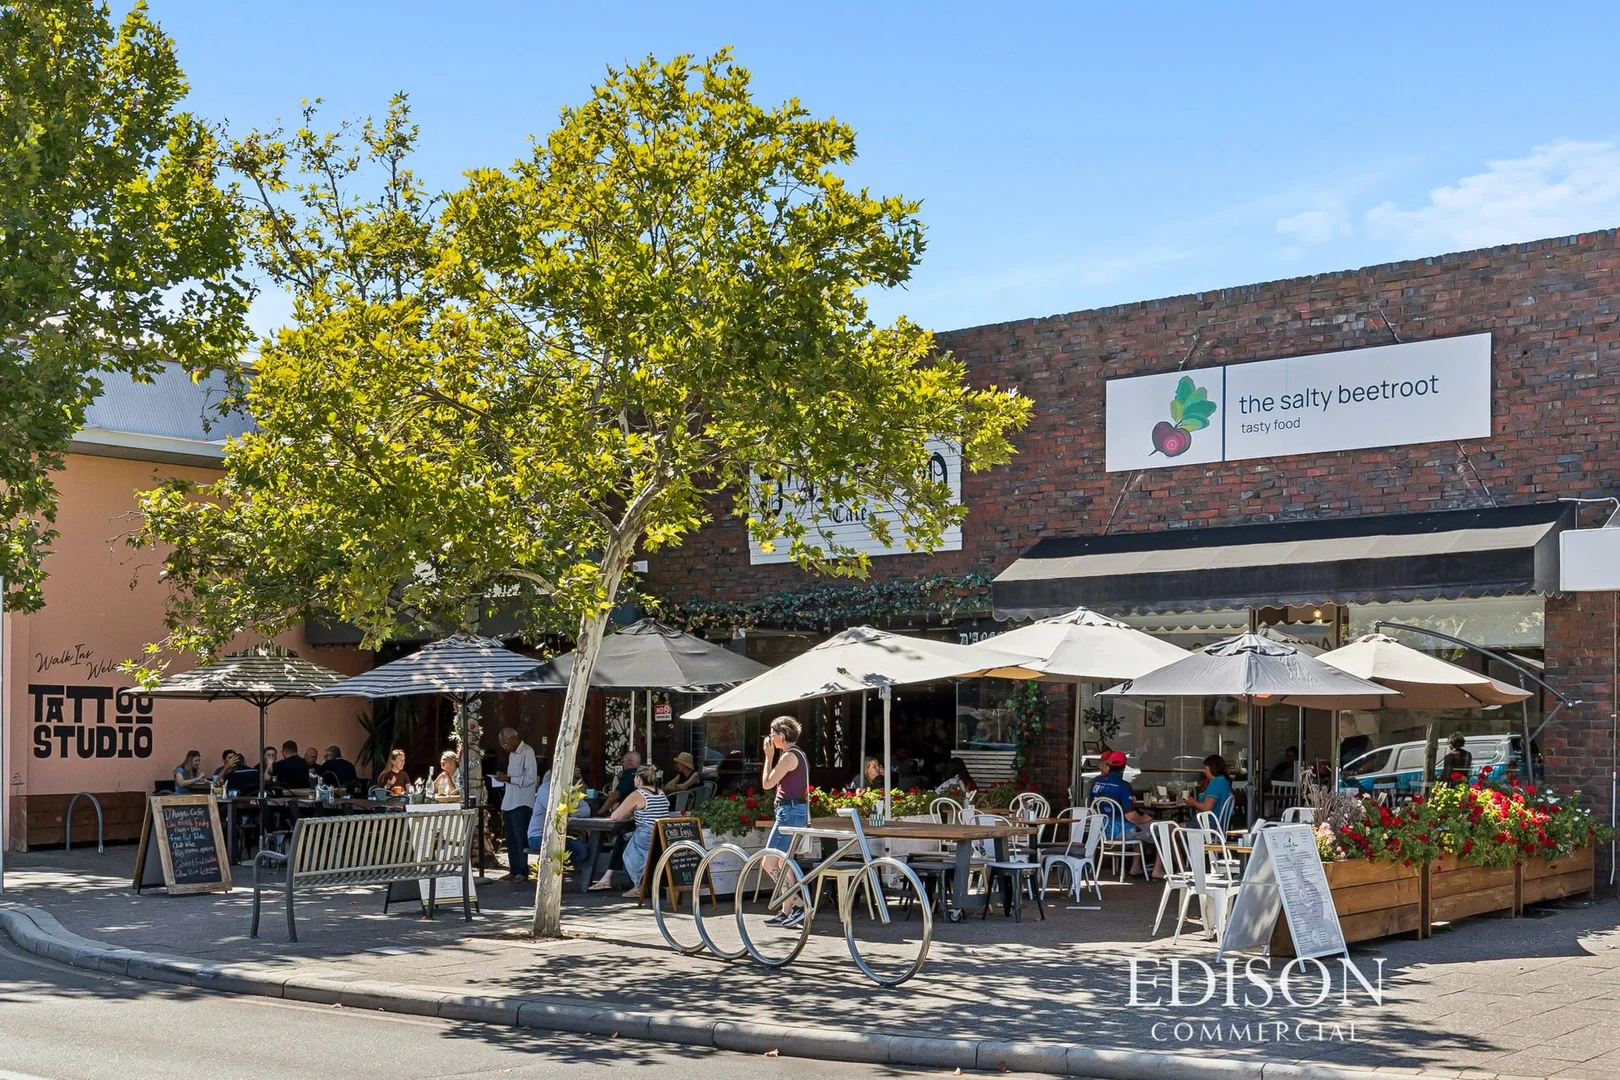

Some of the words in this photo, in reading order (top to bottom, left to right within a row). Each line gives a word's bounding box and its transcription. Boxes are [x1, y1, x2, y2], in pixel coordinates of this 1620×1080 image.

[1238, 394, 1275, 414] the
[1280, 387, 1333, 412] salty
[1338, 374, 1439, 404] beetroot
[1241, 421, 1272, 434] tasty
[1274, 417, 1301, 431] food
[35, 650, 75, 674] Walk
[70, 643, 94, 666] Ins
[28, 684, 154, 724] TATTOO
[33, 724, 153, 759] STUDIO
